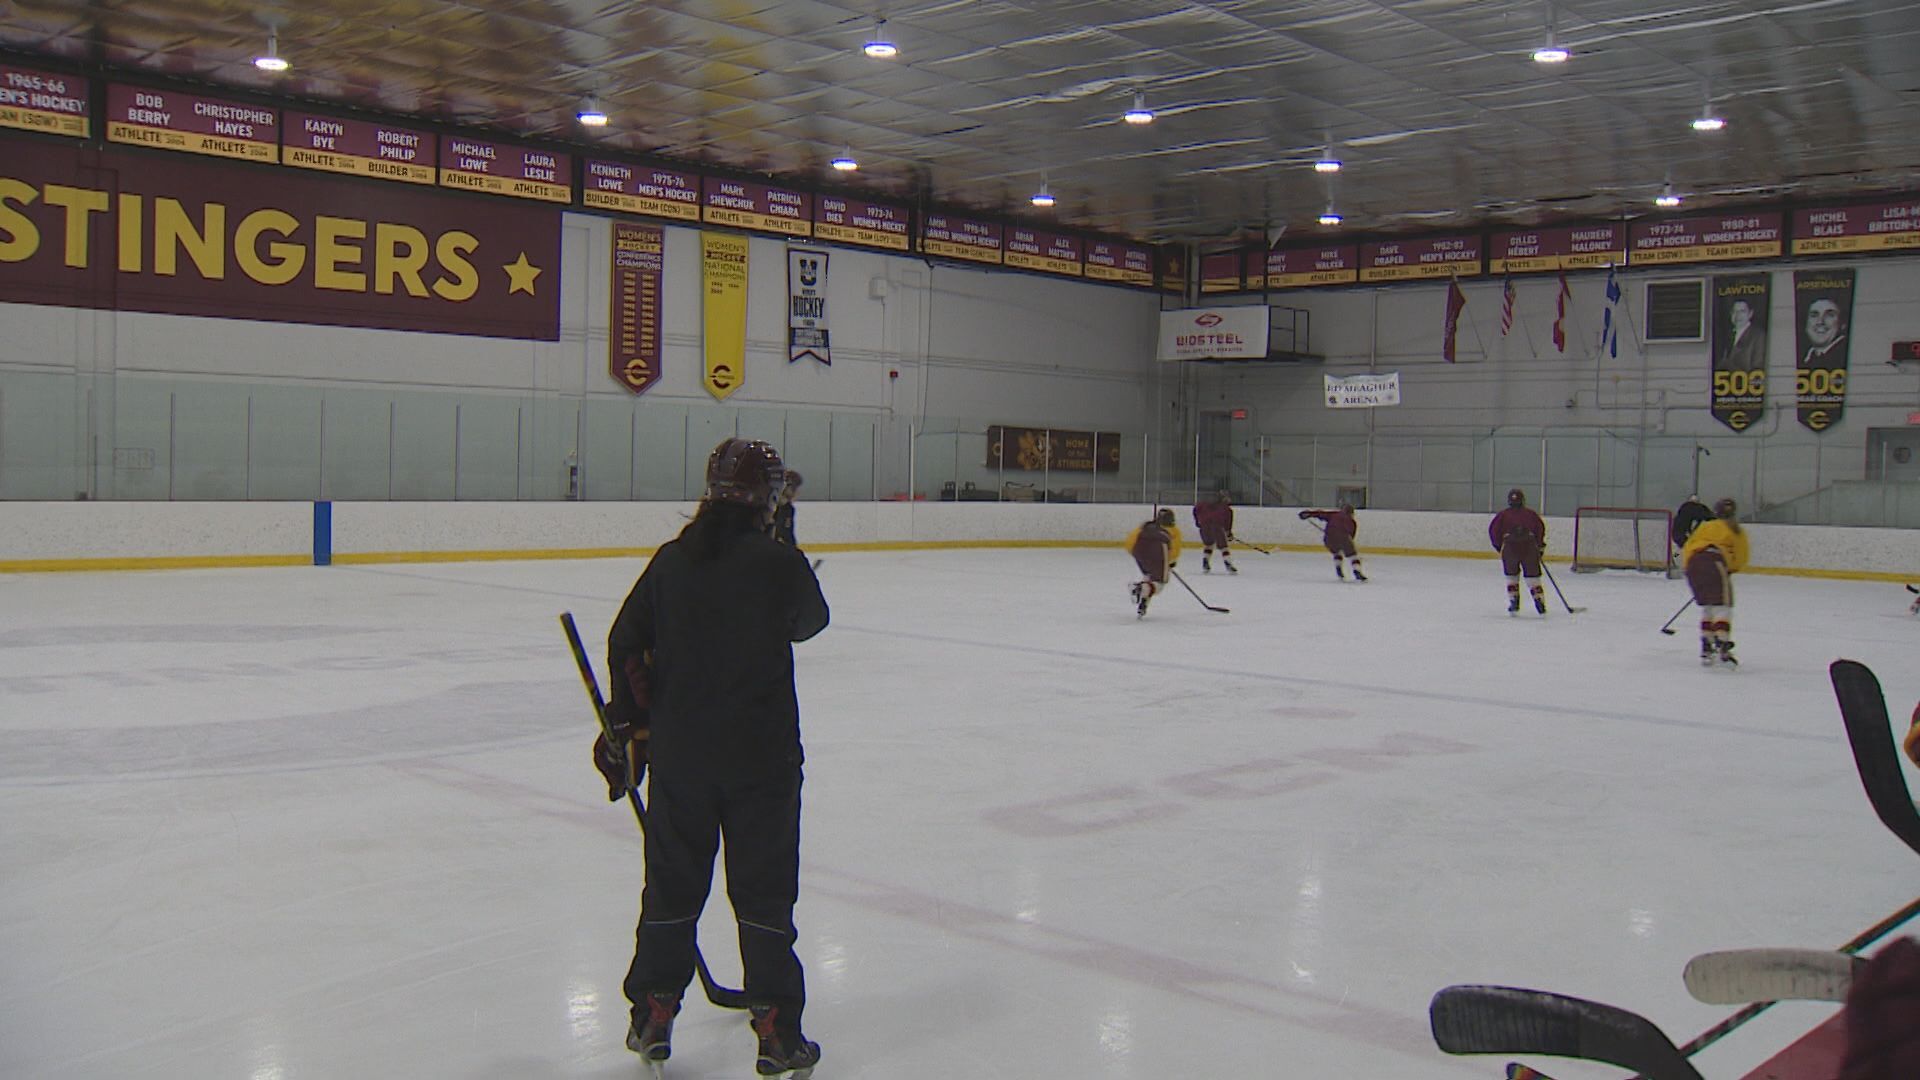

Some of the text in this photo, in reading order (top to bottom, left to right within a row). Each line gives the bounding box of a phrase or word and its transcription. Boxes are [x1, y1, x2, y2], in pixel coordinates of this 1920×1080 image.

[6, 73, 65, 94] 1965-66
[31, 93, 86, 112] HOCKEY
[136, 93, 162, 108] BOB
[128, 108, 170, 126] BERRY
[194, 103, 273, 126] CHRISTOPHER
[215, 121, 253, 138] HAYES
[305, 119, 343, 136] KARYN
[114, 127, 162, 144] ATHLETE
[377, 131, 419, 148] ROBERT
[201, 139, 246, 154] ATHLETE
[313, 135, 335, 150] BYE
[380, 145, 416, 160] PHILIP
[452, 142, 496, 160] MICHAEL
[293, 152, 334, 167] ATHLETE
[460, 157, 488, 172] LOWE
[524, 153, 556, 168] LAURA
[368, 162, 408, 176] BUILDER
[524, 168, 555, 182] LESLIE
[590, 163, 631, 180] KENNETH
[447, 173, 483, 188] ATHLETE
[598, 178, 623, 192] LOWE
[653, 173, 685, 188] 1975-76
[513, 183, 548, 196] ATHLETE
[639, 184, 697, 202] MEN'S HOCKEY
[720, 183, 744, 196] MARK
[586, 193, 620, 206] BUILDER
[640, 200, 659, 210] TEAM
[710, 194, 755, 210] SHEWCHUK
[767, 191, 802, 206] PATRICIA
[769, 203, 799, 217] CHIARA
[824, 199, 846, 212] DAVID
[710, 210, 739, 223] ATHLETE
[1809, 211, 1848, 224] MICHEL
[763, 218, 791, 230] ATHLETE
[816, 225, 841, 236] ATHLETE
[852, 216, 906, 232] WOMEN'S HOCKEY
[1813, 224, 1844, 236] BLAIS
[0, 177, 480, 301] STINGERS
[617, 229, 661, 242] WOMEN'S
[857, 231, 873, 240] TEAM
[1510, 235, 1537, 246] GILLES
[1571, 229, 1612, 241] MAUREEN
[1637, 234, 1696, 248] MEN'S HOCKEY
[1703, 228, 1778, 244] WOMEN'S HOCKEY
[623, 242, 657, 250] HOCKEY
[706, 240, 746, 253] WOMEN'S
[1009, 241, 1039, 254] CHAPMAN
[1055, 238, 1069, 248] ALEX
[1571, 241, 1612, 253] MALONEY
[1799, 240, 1837, 250] ATHLETE
[1048, 247, 1076, 260] MATTHEW
[1379, 245, 1399, 255] DAVE
[1420, 250, 1476, 263] MEN'S HOCKEY
[1706, 247, 1728, 256] TEAM
[1374, 255, 1404, 266] DRAPER
[1568, 255, 1598, 264] ATHLETE
[1634, 253, 1655, 261] TEAM
[616, 259, 661, 270] CHAMPIONS
[705, 261, 745, 273] NATIONAL
[1315, 261, 1344, 270] WALKER
[1421, 266, 1439, 274] TEAM
[1369, 269, 1396, 278] BUILDER
[1718, 285, 1765, 296] LAWTON
[1797, 280, 1851, 289] ARSENAULT
[793, 295, 824, 319] HOCKEY
[1176, 333, 1243, 346] BIOSTEEL
[1344, 382, 1396, 392] MEAGHER
[1714, 370, 1765, 396] 500
[1796, 369, 1846, 395] 500
[1343, 395, 1378, 404] ARENA
[1065, 440, 1089, 448] HOME
